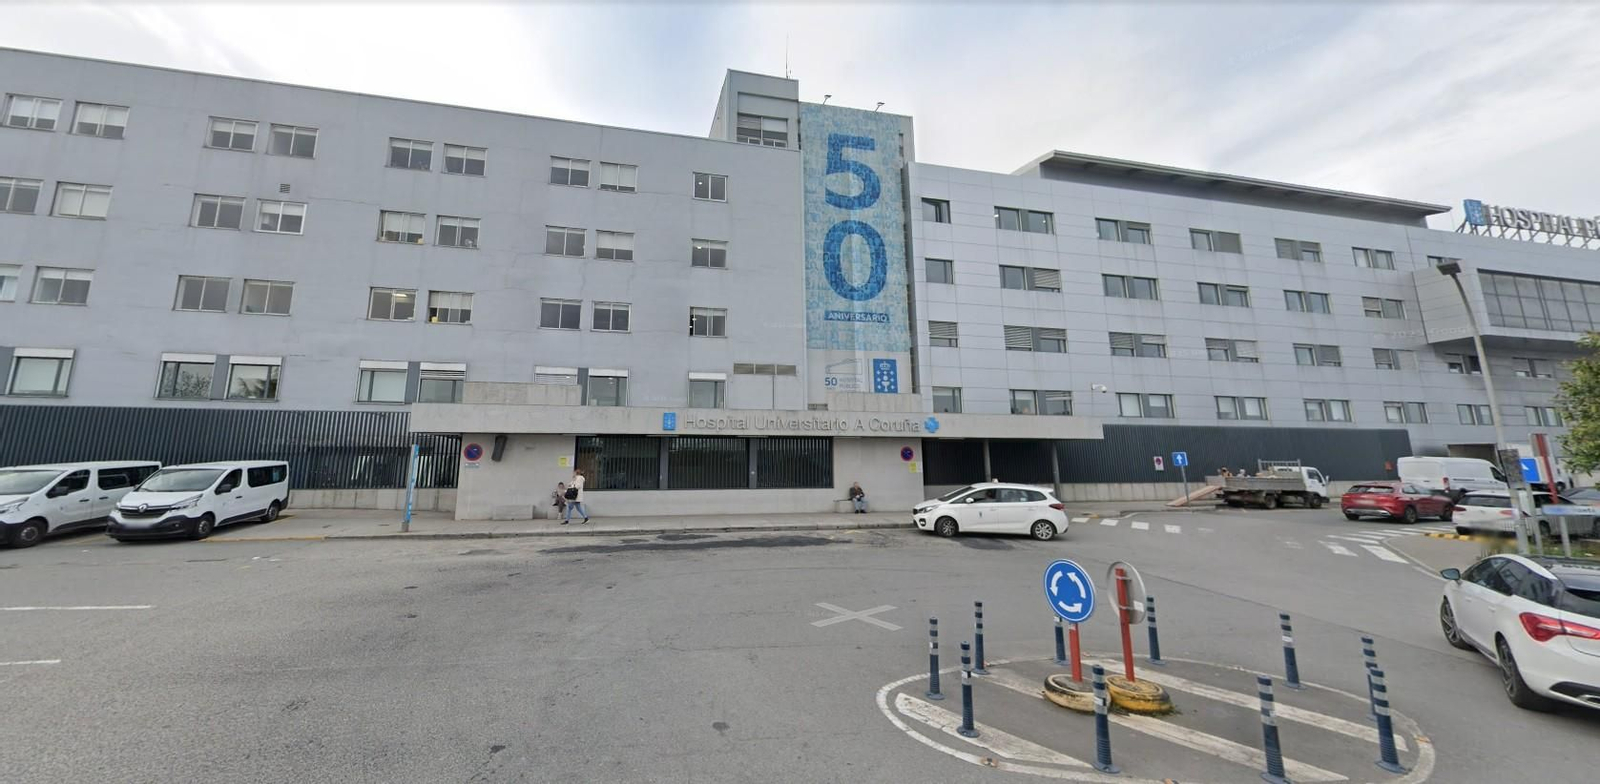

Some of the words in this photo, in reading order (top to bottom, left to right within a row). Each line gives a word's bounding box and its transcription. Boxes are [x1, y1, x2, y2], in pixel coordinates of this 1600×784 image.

[823, 133, 888, 302] 50
[1482, 205, 1582, 235] HOSPITAL
[828, 312, 888, 322] ANIVERSARIO
[824, 377, 837, 386] 50
[684, 413, 749, 432] Hospital
[755, 414, 848, 432] Universitario
[853, 418, 866, 432] A
[868, 416, 920, 433] Coruña
